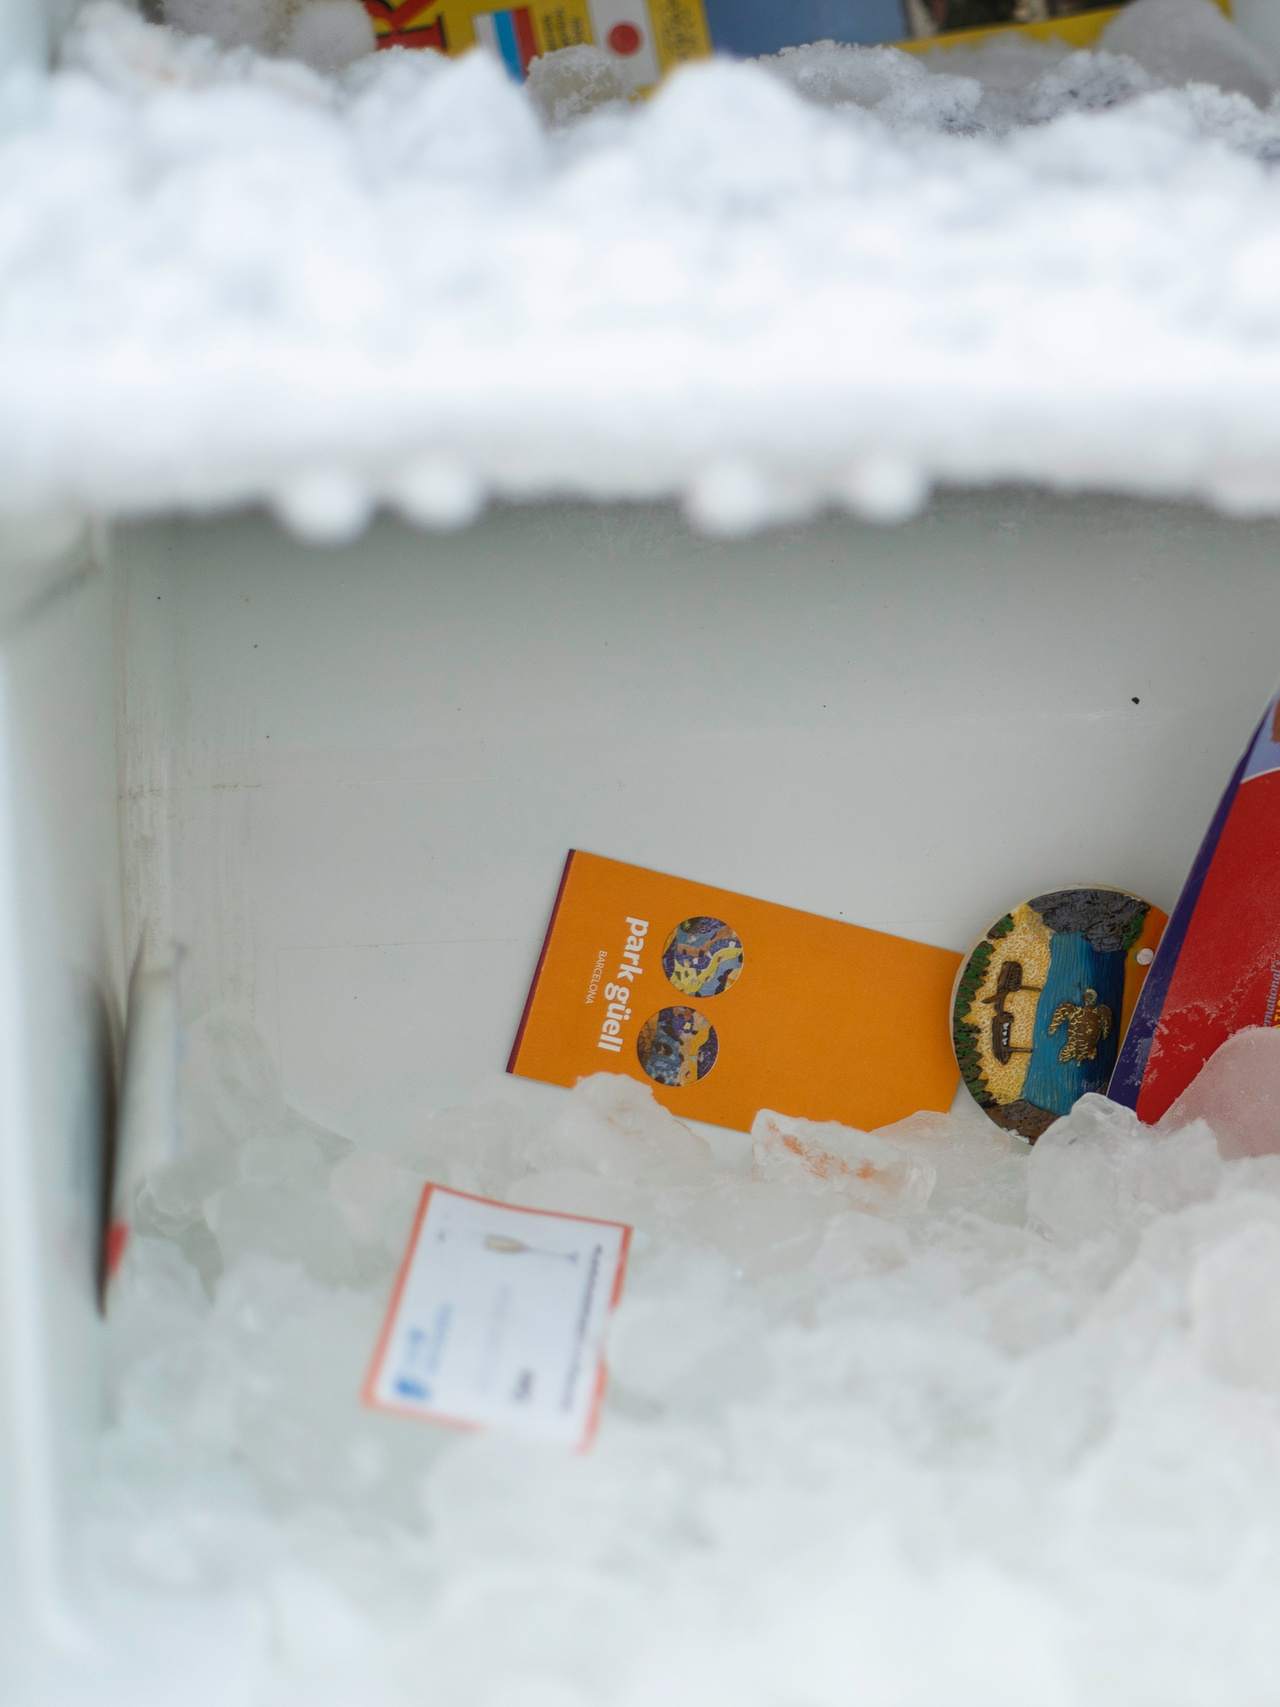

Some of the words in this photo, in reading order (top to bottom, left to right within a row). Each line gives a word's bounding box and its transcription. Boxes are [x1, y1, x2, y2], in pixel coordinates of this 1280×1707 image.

[585, 950, 608, 1004] BARCELONA
[617, 916, 649, 983] park
[597, 982, 632, 1052] güell
